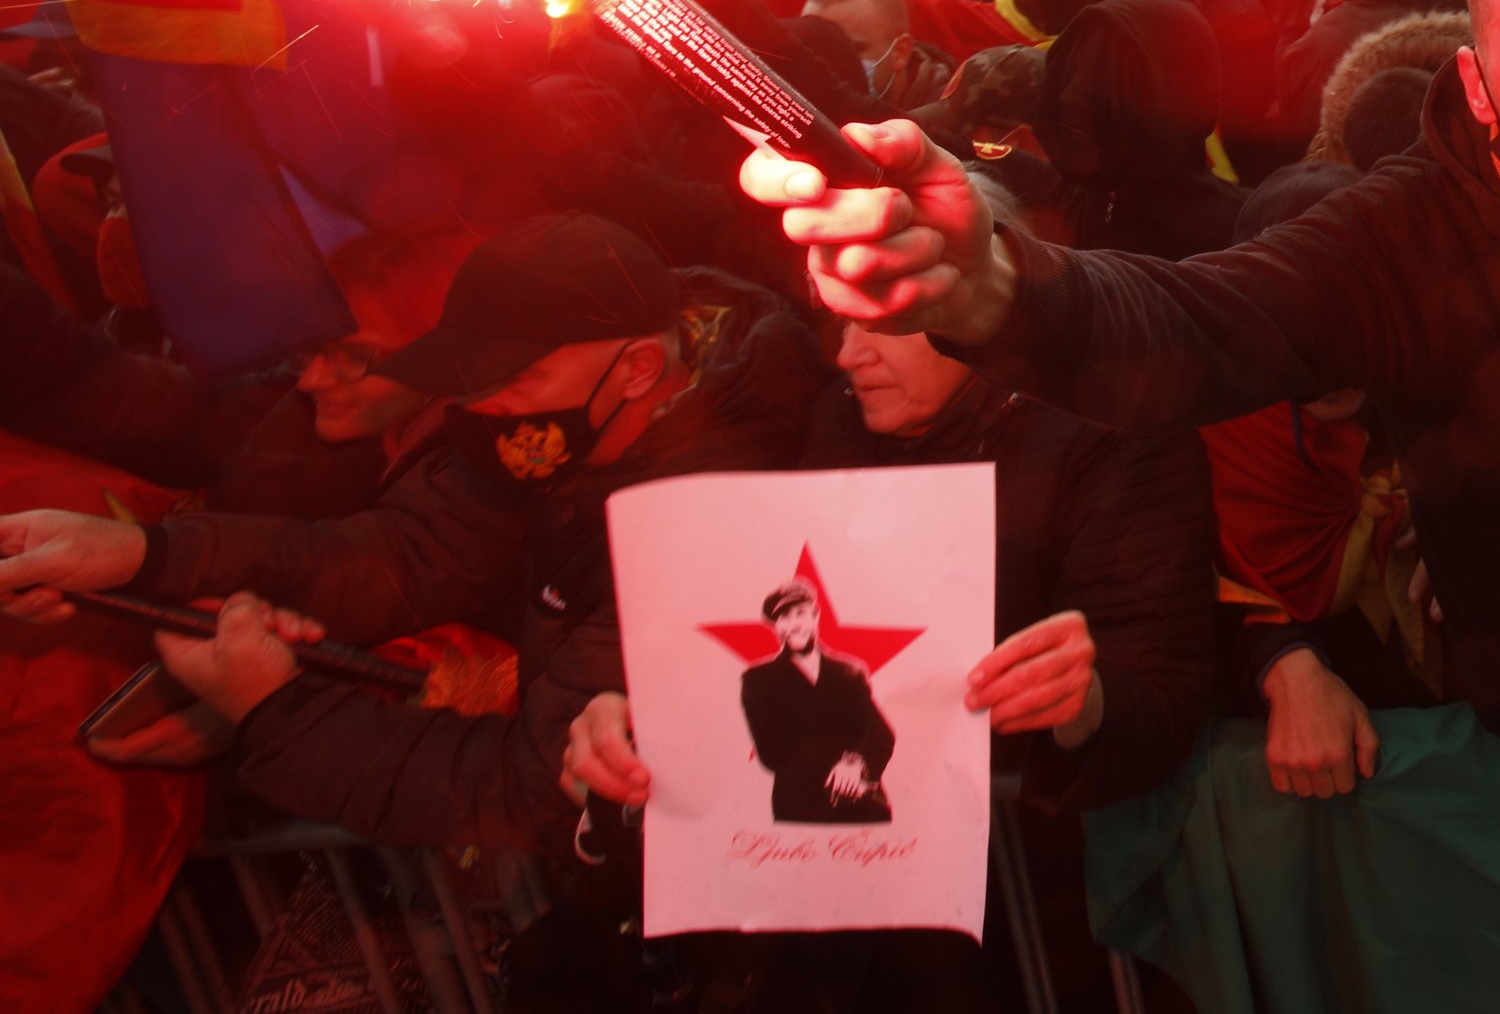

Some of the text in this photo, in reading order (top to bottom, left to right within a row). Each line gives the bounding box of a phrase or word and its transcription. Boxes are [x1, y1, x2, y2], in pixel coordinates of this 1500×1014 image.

[630, 14, 645, 26] the
[661, 40, 679, 55] flare
[675, 51, 686, 61] to
[682, 57, 696, 69] the
[691, 65, 716, 87] ground
[712, 82, 746, 112] concerning
[743, 109, 755, 119] the
[752, 116, 772, 133] safety
[769, 130, 778, 138] of
[655, 13, 670, 26] the
[678, 32, 690, 42] of
[686, 39, 699, 51] the
[696, 47, 713, 62] flare
[709, 59, 733, 80] briskly
[729, 76, 754, 97] against
[751, 94, 763, 105] the
[760, 103, 781, 121] coarse
[778, 118, 803, 139] striking
[677, 21, 691, 33] the
[688, 30, 705, 45] flare
[718, 56, 732, 68] the
[728, 66, 746, 81] same
[744, 79, 758, 92] way
[756, 89, 766, 97] as
[763, 96, 777, 108] you
[774, 104, 790, 118] light
[702, 25, 720, 40] away
[718, 37, 735, 52] from
[732, 50, 747, 64] your
[779, 89, 793, 101] with
[790, 100, 804, 112] your
[713, 41, 726, 52] the
[739, 64, 757, 79] Point
[758, 82, 775, 96] away
[774, 93, 790, 107] from
[786, 104, 811, 126] yourself
